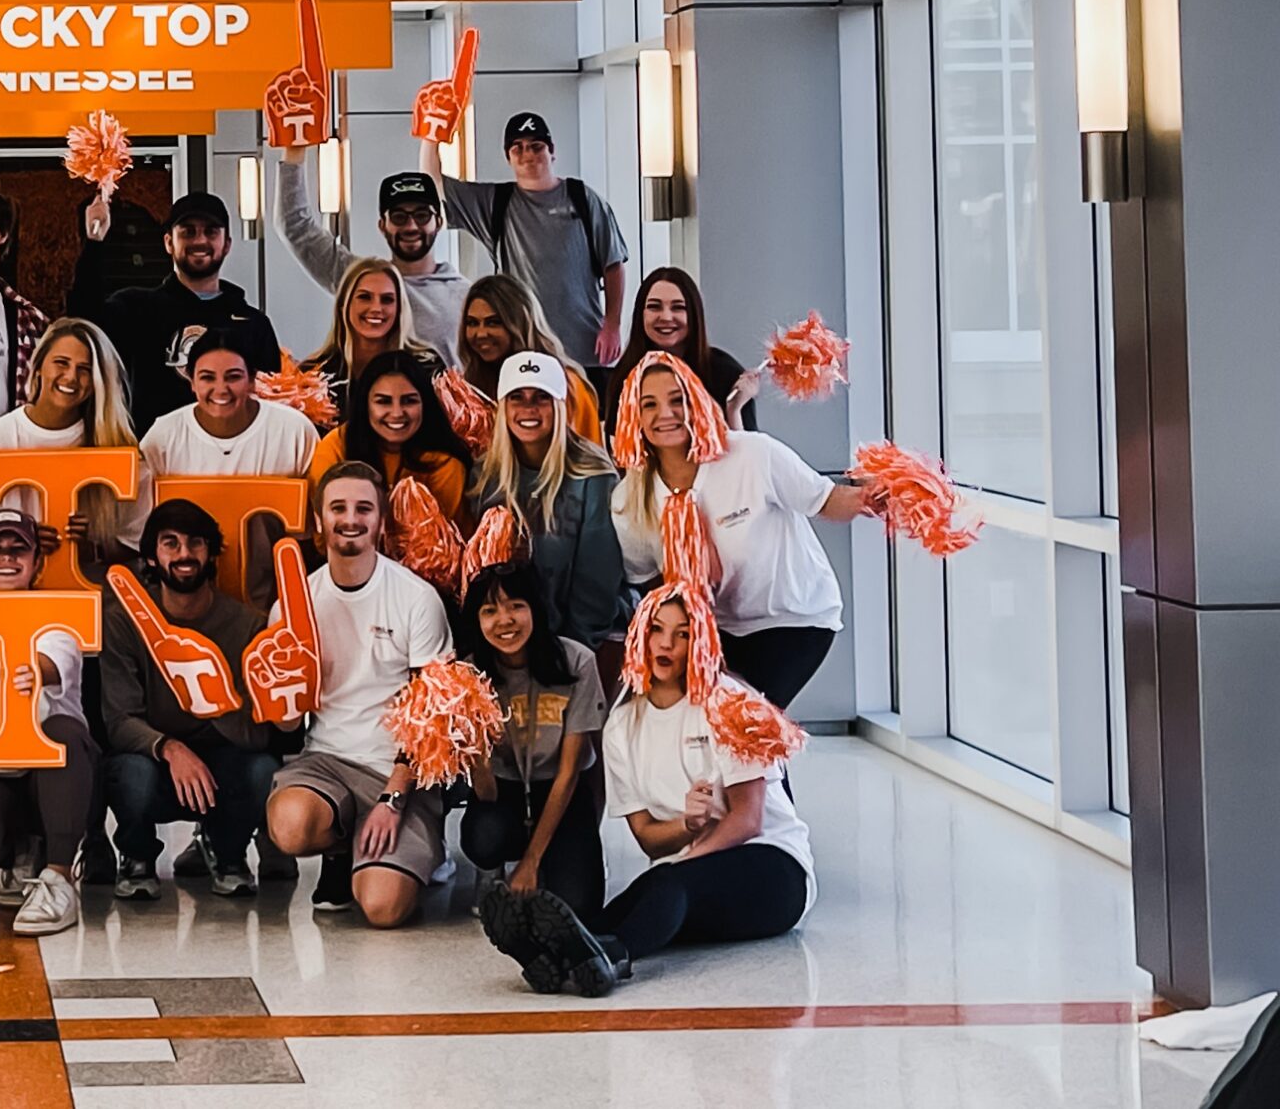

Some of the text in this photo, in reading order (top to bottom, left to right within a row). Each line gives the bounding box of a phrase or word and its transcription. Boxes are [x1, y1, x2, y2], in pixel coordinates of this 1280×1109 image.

[132, 3, 249, 46] TOP
[282, 113, 315, 146] T
[423, 115, 449, 141] T
[164, 658, 219, 715] T
[270, 682, 308, 722] T
